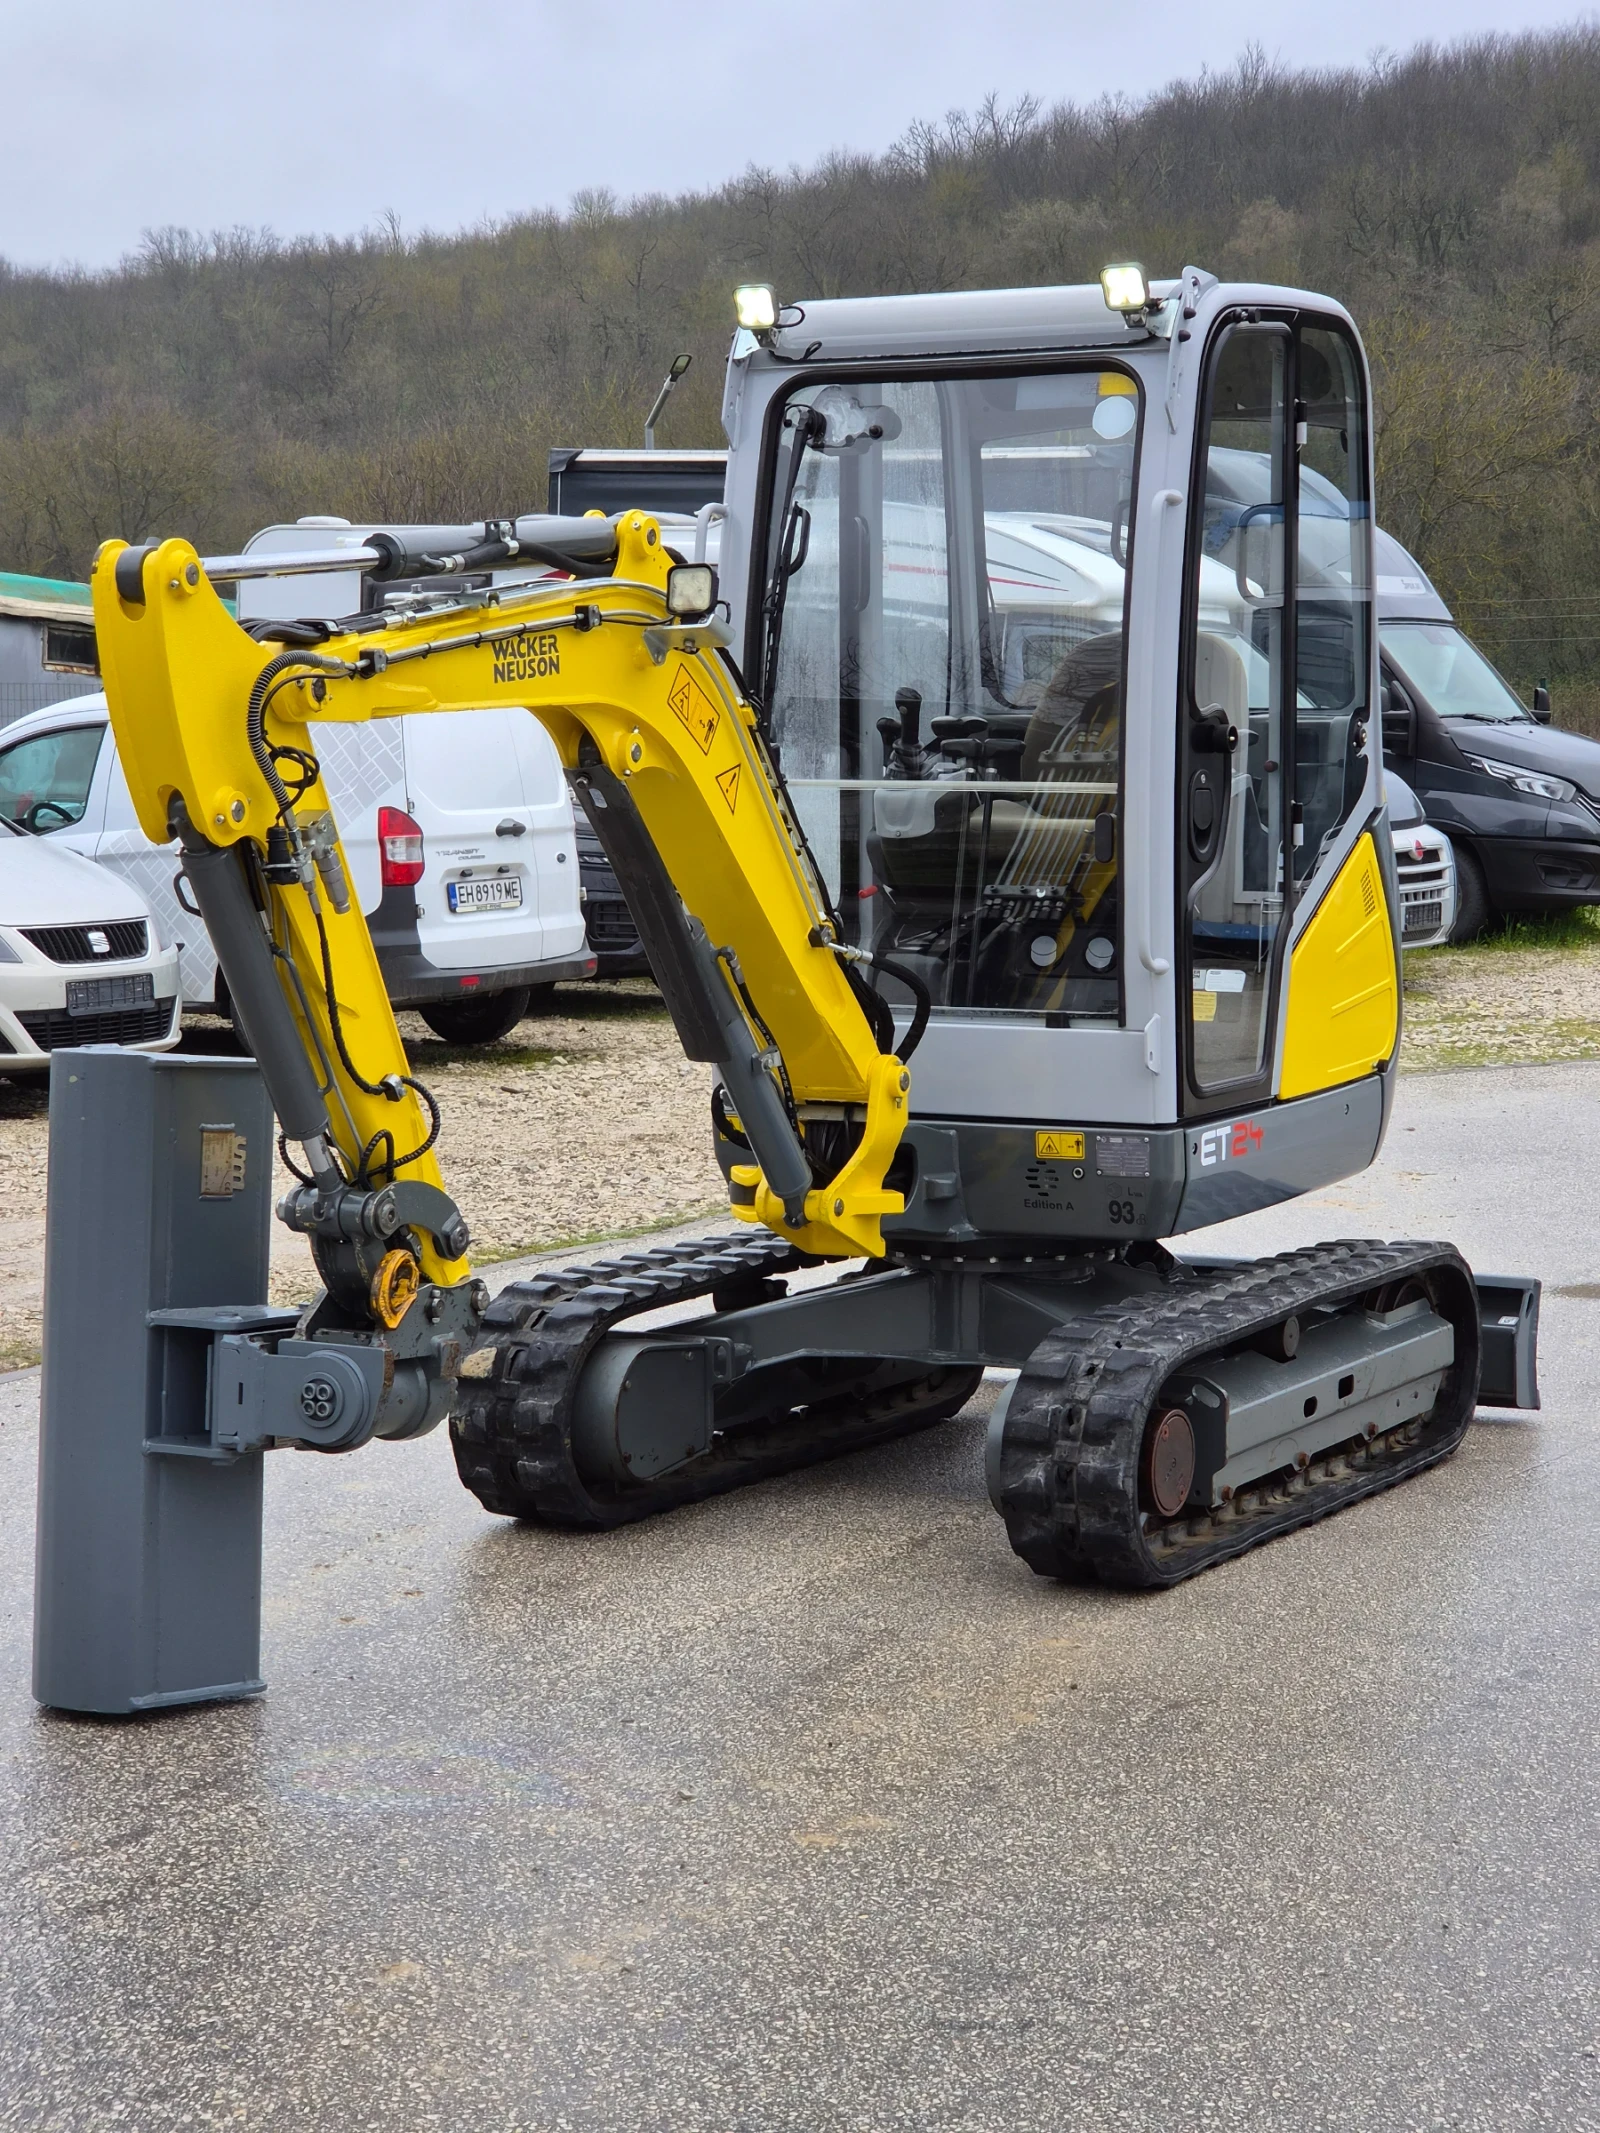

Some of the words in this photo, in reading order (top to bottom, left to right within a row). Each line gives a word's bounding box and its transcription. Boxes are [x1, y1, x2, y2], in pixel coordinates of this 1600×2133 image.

[491, 634, 559, 662] WACKER
[493, 655, 560, 684] NEUSON
[1023, 1198, 1063, 1211] Edition
[1066, 1201, 1075, 1211] A
[1108, 1200, 1135, 1225] 93
